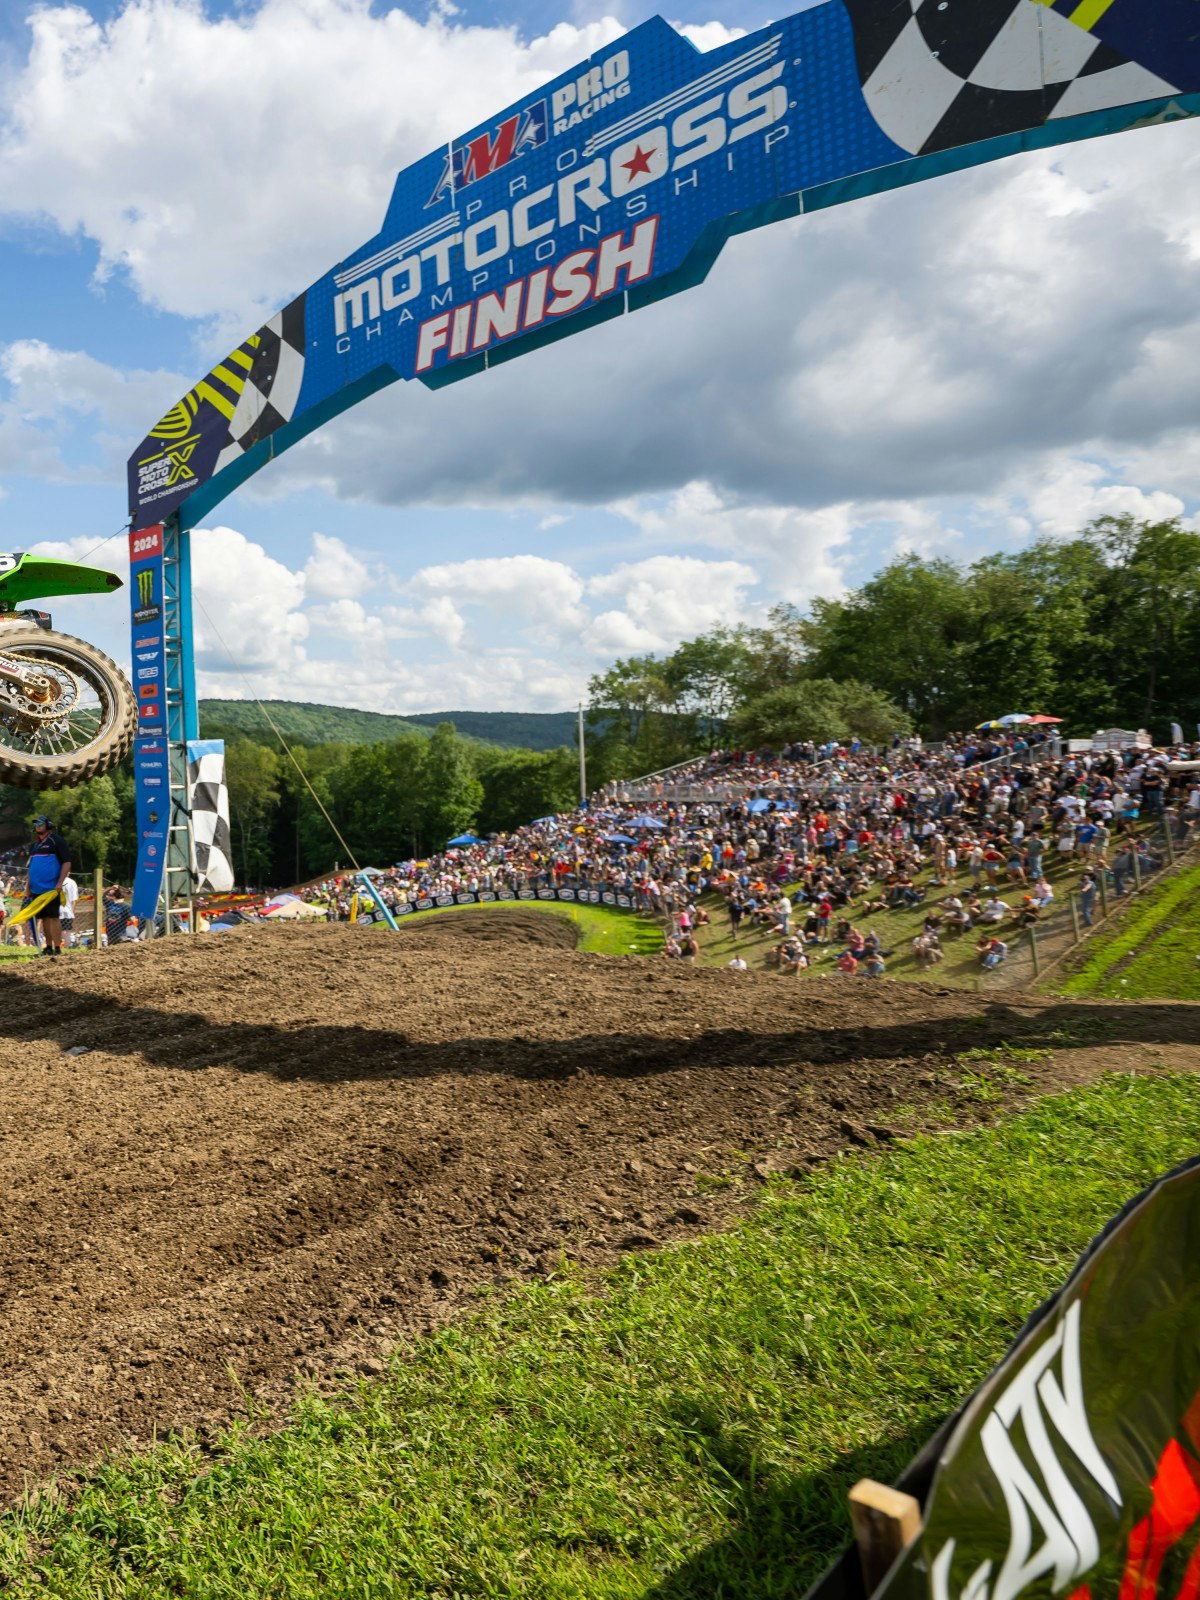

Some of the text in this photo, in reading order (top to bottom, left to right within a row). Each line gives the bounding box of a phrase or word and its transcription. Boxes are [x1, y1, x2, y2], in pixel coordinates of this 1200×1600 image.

[551, 50, 630, 120] PRO
[553, 81, 631, 136] RACING
[423, 98, 549, 210] AMA
[466, 148, 578, 221] PRO
[334, 59, 788, 336] MOTOCROSS
[335, 125, 790, 354] CHAMPIONSHIP
[415, 214, 660, 375] FINISH
[138, 457, 172, 477] SUPER
[138, 475, 169, 494] CROSS
[139, 478, 199, 505] WORLD CHAMPIONSHIP
[140, 466, 169, 485] MOTO
[133, 534, 159, 553] 2024
